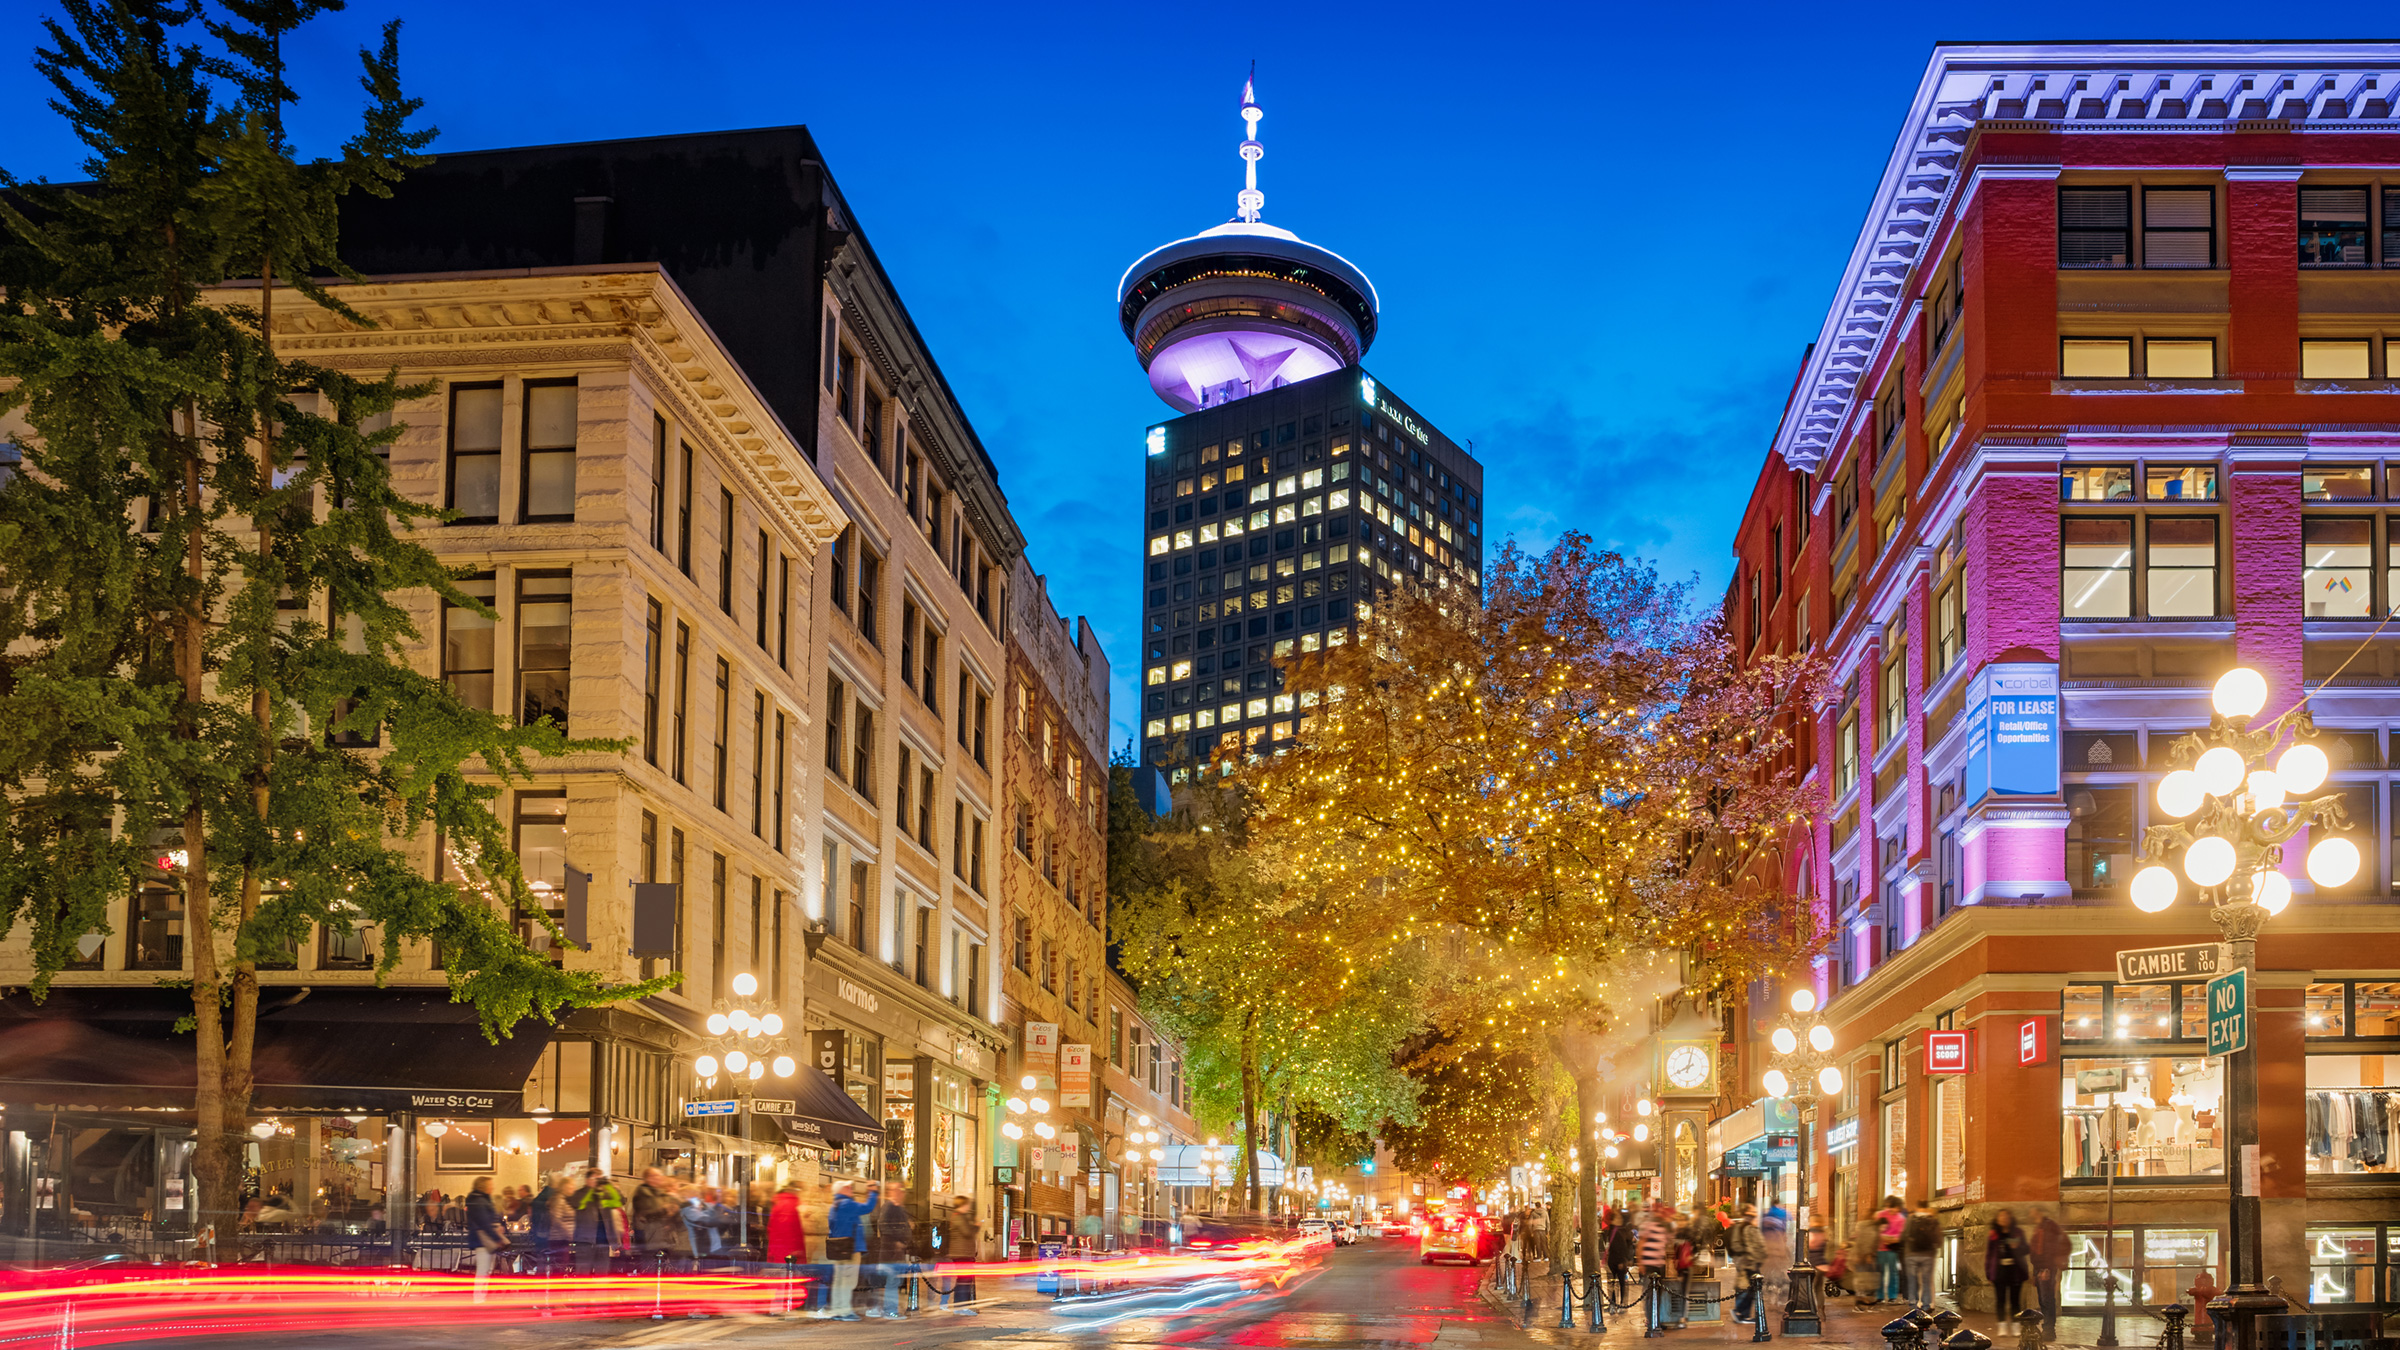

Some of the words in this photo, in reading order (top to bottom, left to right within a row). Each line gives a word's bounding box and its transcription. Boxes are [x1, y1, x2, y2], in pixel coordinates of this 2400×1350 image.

[2004, 677, 2053, 689] corbel
[1992, 701, 2015, 715] FOR
[2019, 701, 2055, 715] LEASE
[1999, 721, 2048, 732] Retail/Office
[1997, 733, 2050, 744] Opportunities
[2127, 952, 2187, 976] CAMBIE
[2199, 950, 2209, 961] ST
[2198, 960, 2215, 971] 100
[2216, 983, 2236, 1013] NO
[2211, 1013, 2241, 1046] EXIT
[1935, 1051, 1960, 1059] SCOOP
[757, 1102, 781, 1112] CAMBIE
[2157, 1147, 2187, 1156] SCOOP
[248, 1158, 295, 1177] WATER
